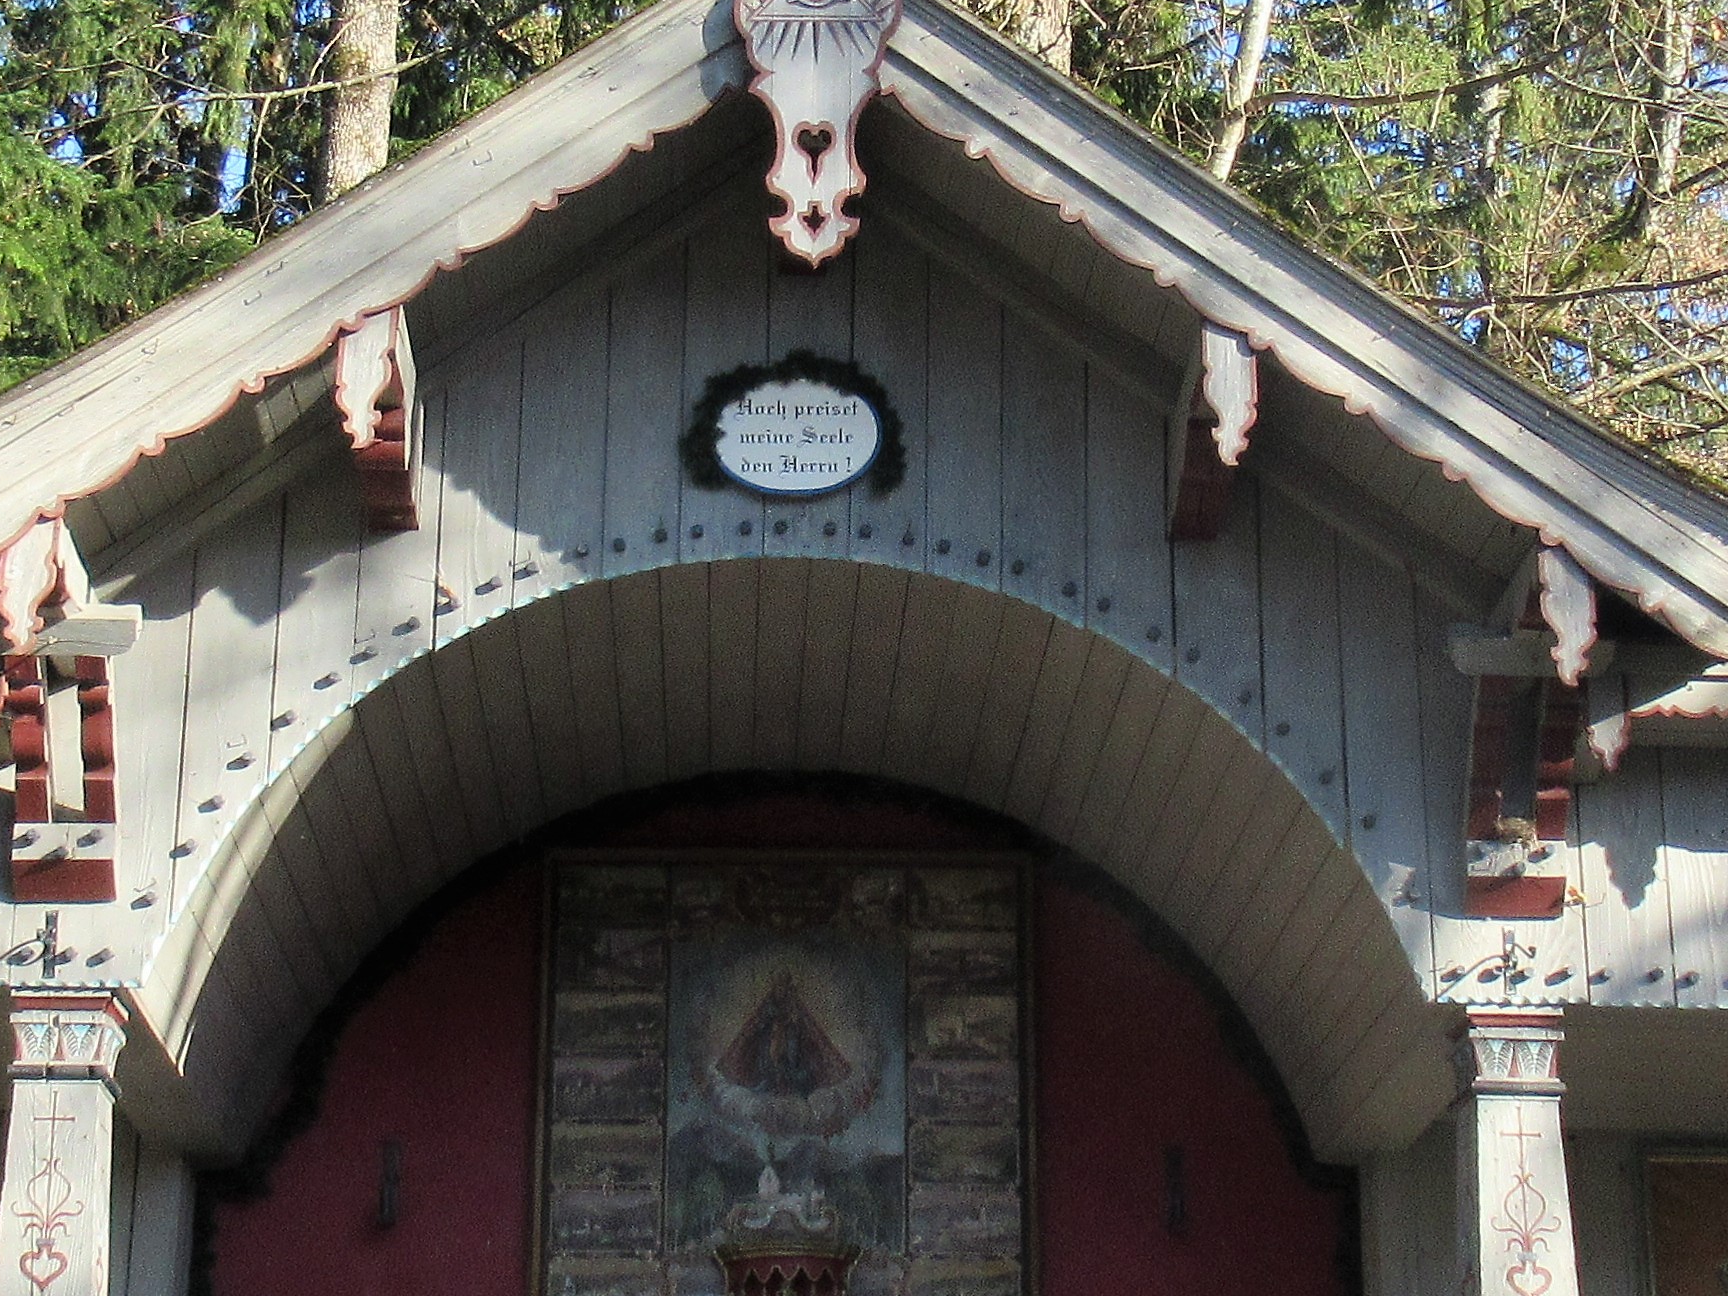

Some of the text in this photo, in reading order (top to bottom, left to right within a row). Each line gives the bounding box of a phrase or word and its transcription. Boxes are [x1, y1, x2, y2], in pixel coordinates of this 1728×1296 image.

[734, 399, 858, 421] Hoch preiset
[739, 425, 854, 448] meine Seele
[741, 457, 773, 473] den
[779, 455, 838, 478] Herrn
